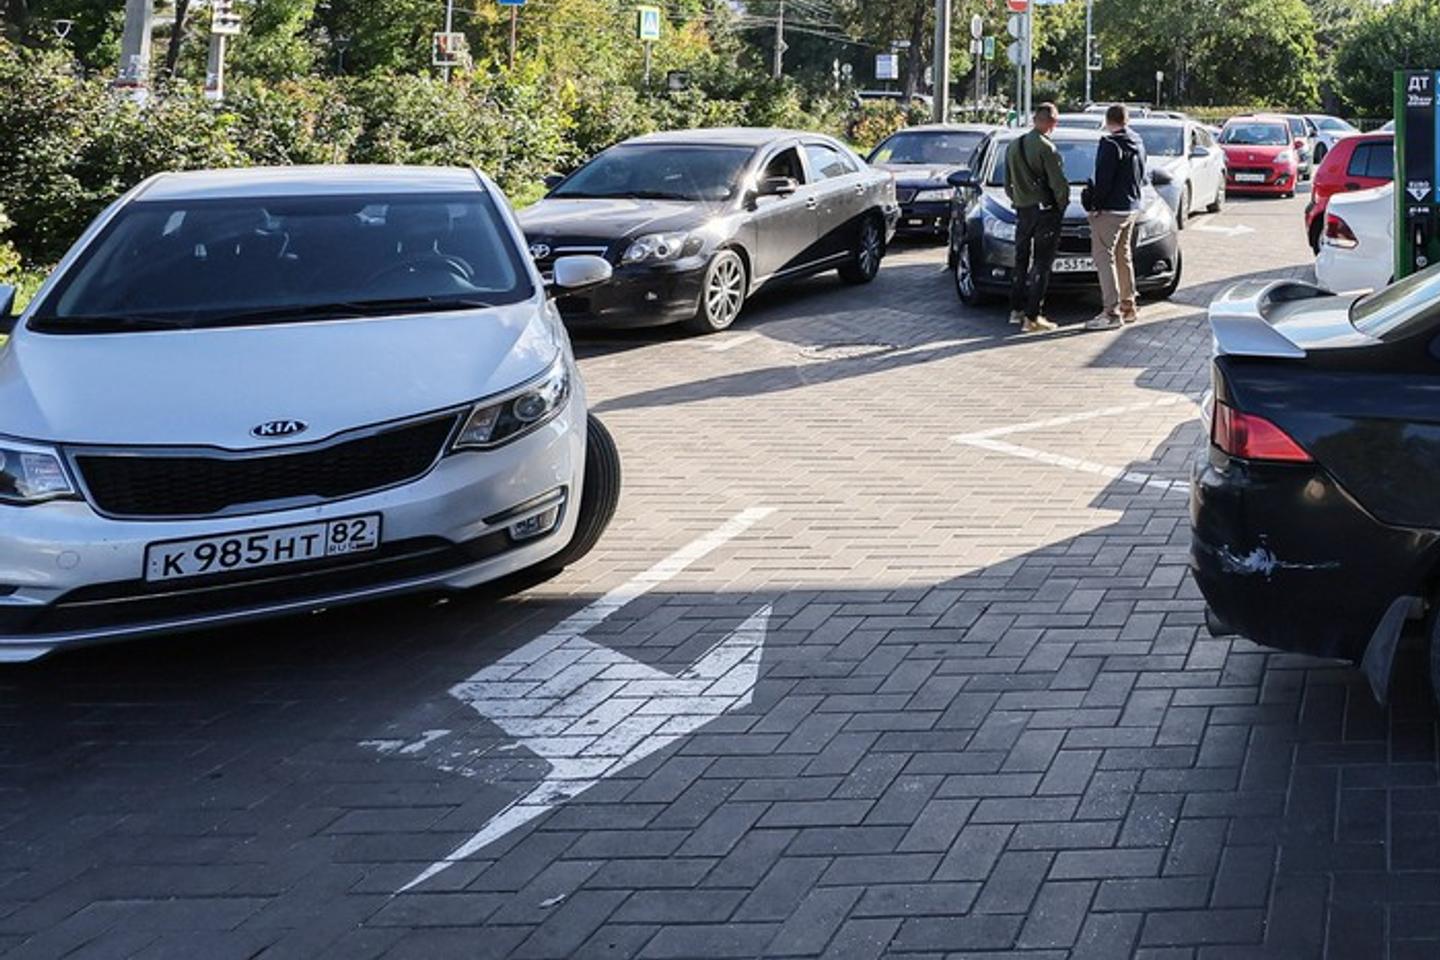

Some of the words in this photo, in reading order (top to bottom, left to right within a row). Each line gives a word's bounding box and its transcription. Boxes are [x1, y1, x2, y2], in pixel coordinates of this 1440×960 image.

[1408, 77, 1430, 91] ДТ
[260, 419, 298, 434] KIA
[163, 535, 319, 576] К985НТ
[331, 520, 367, 543] 82
